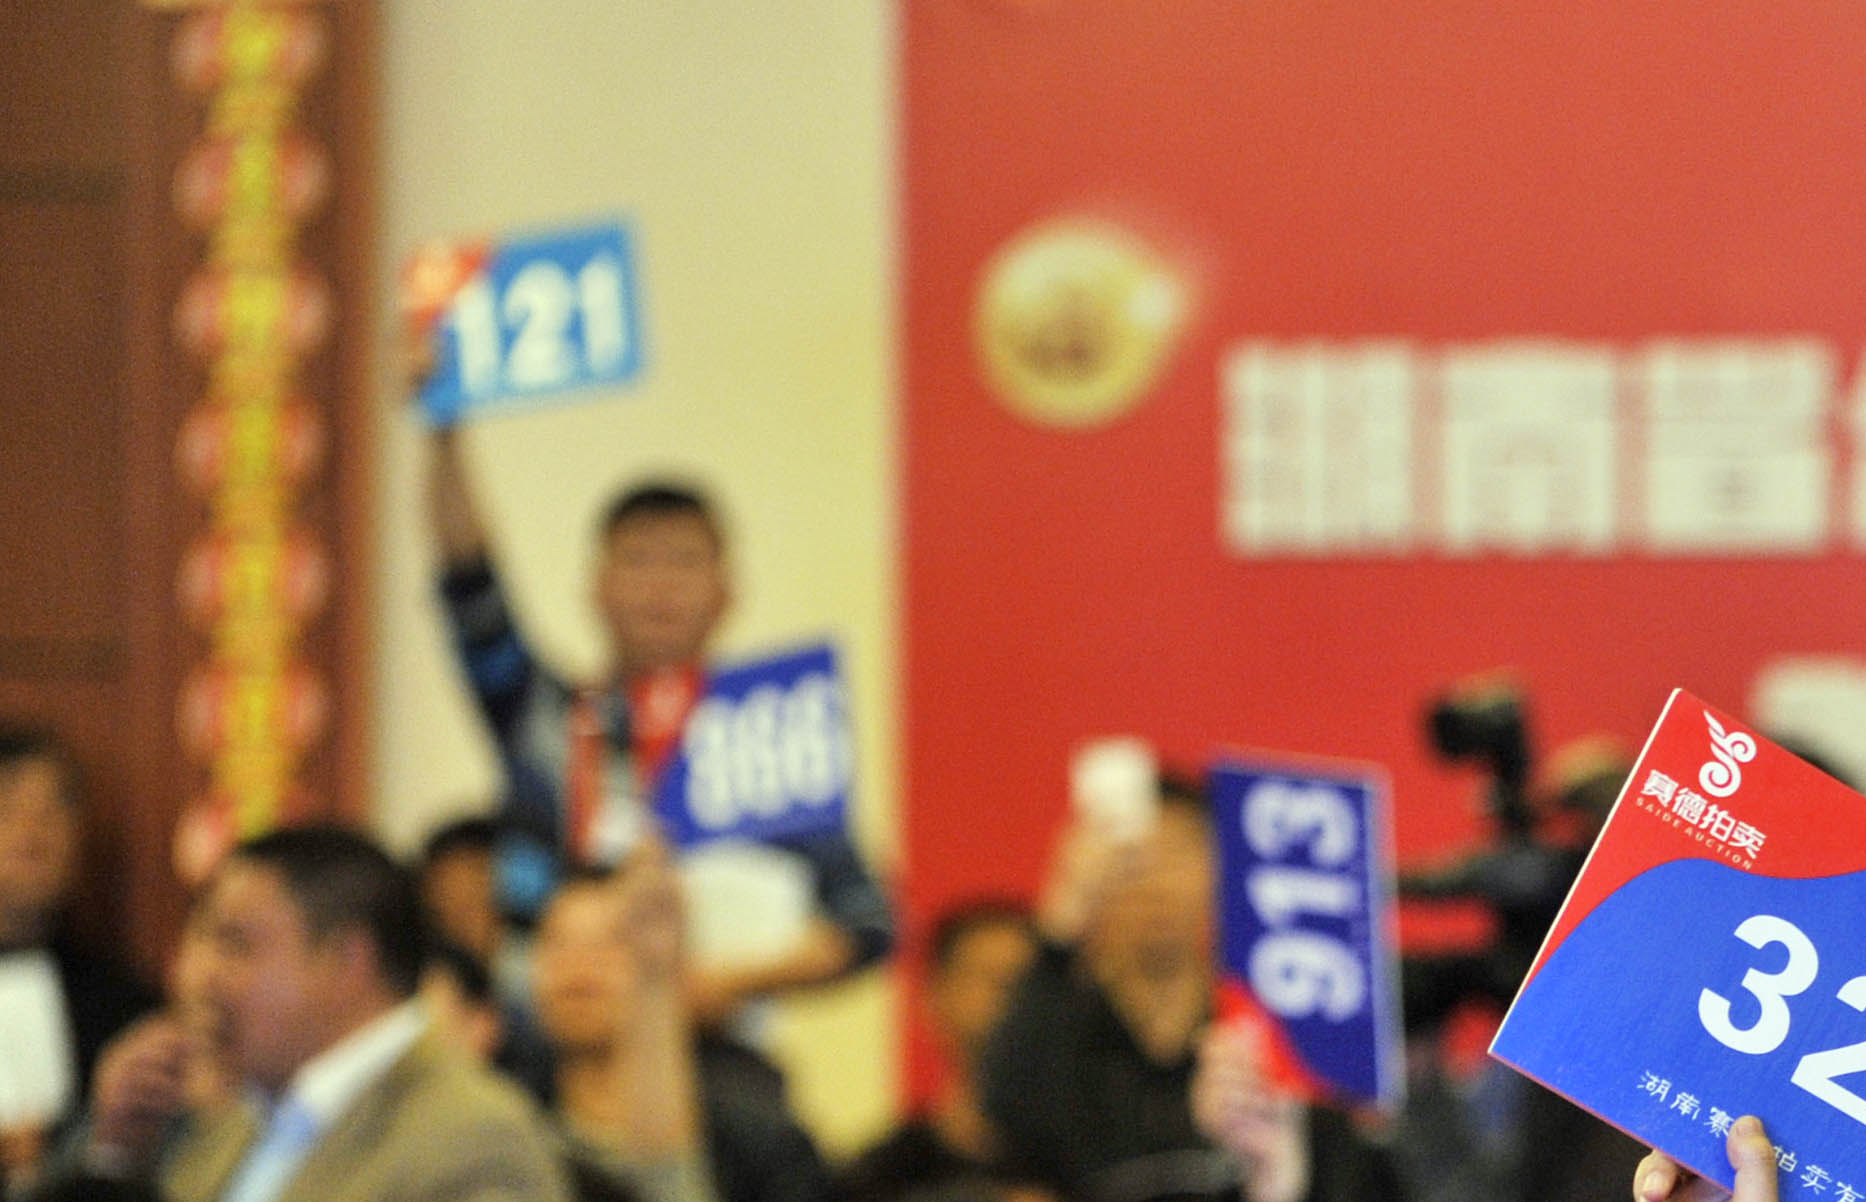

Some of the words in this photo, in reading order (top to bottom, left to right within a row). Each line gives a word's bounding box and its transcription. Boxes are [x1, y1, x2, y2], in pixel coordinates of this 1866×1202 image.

[452, 256, 629, 393] 121
[1636, 797, 1682, 829] SAIDE
[1684, 826, 1754, 871] AUCTION
[1640, 769, 1767, 859] 赛德拍卖
[1243, 780, 1366, 1024] 913
